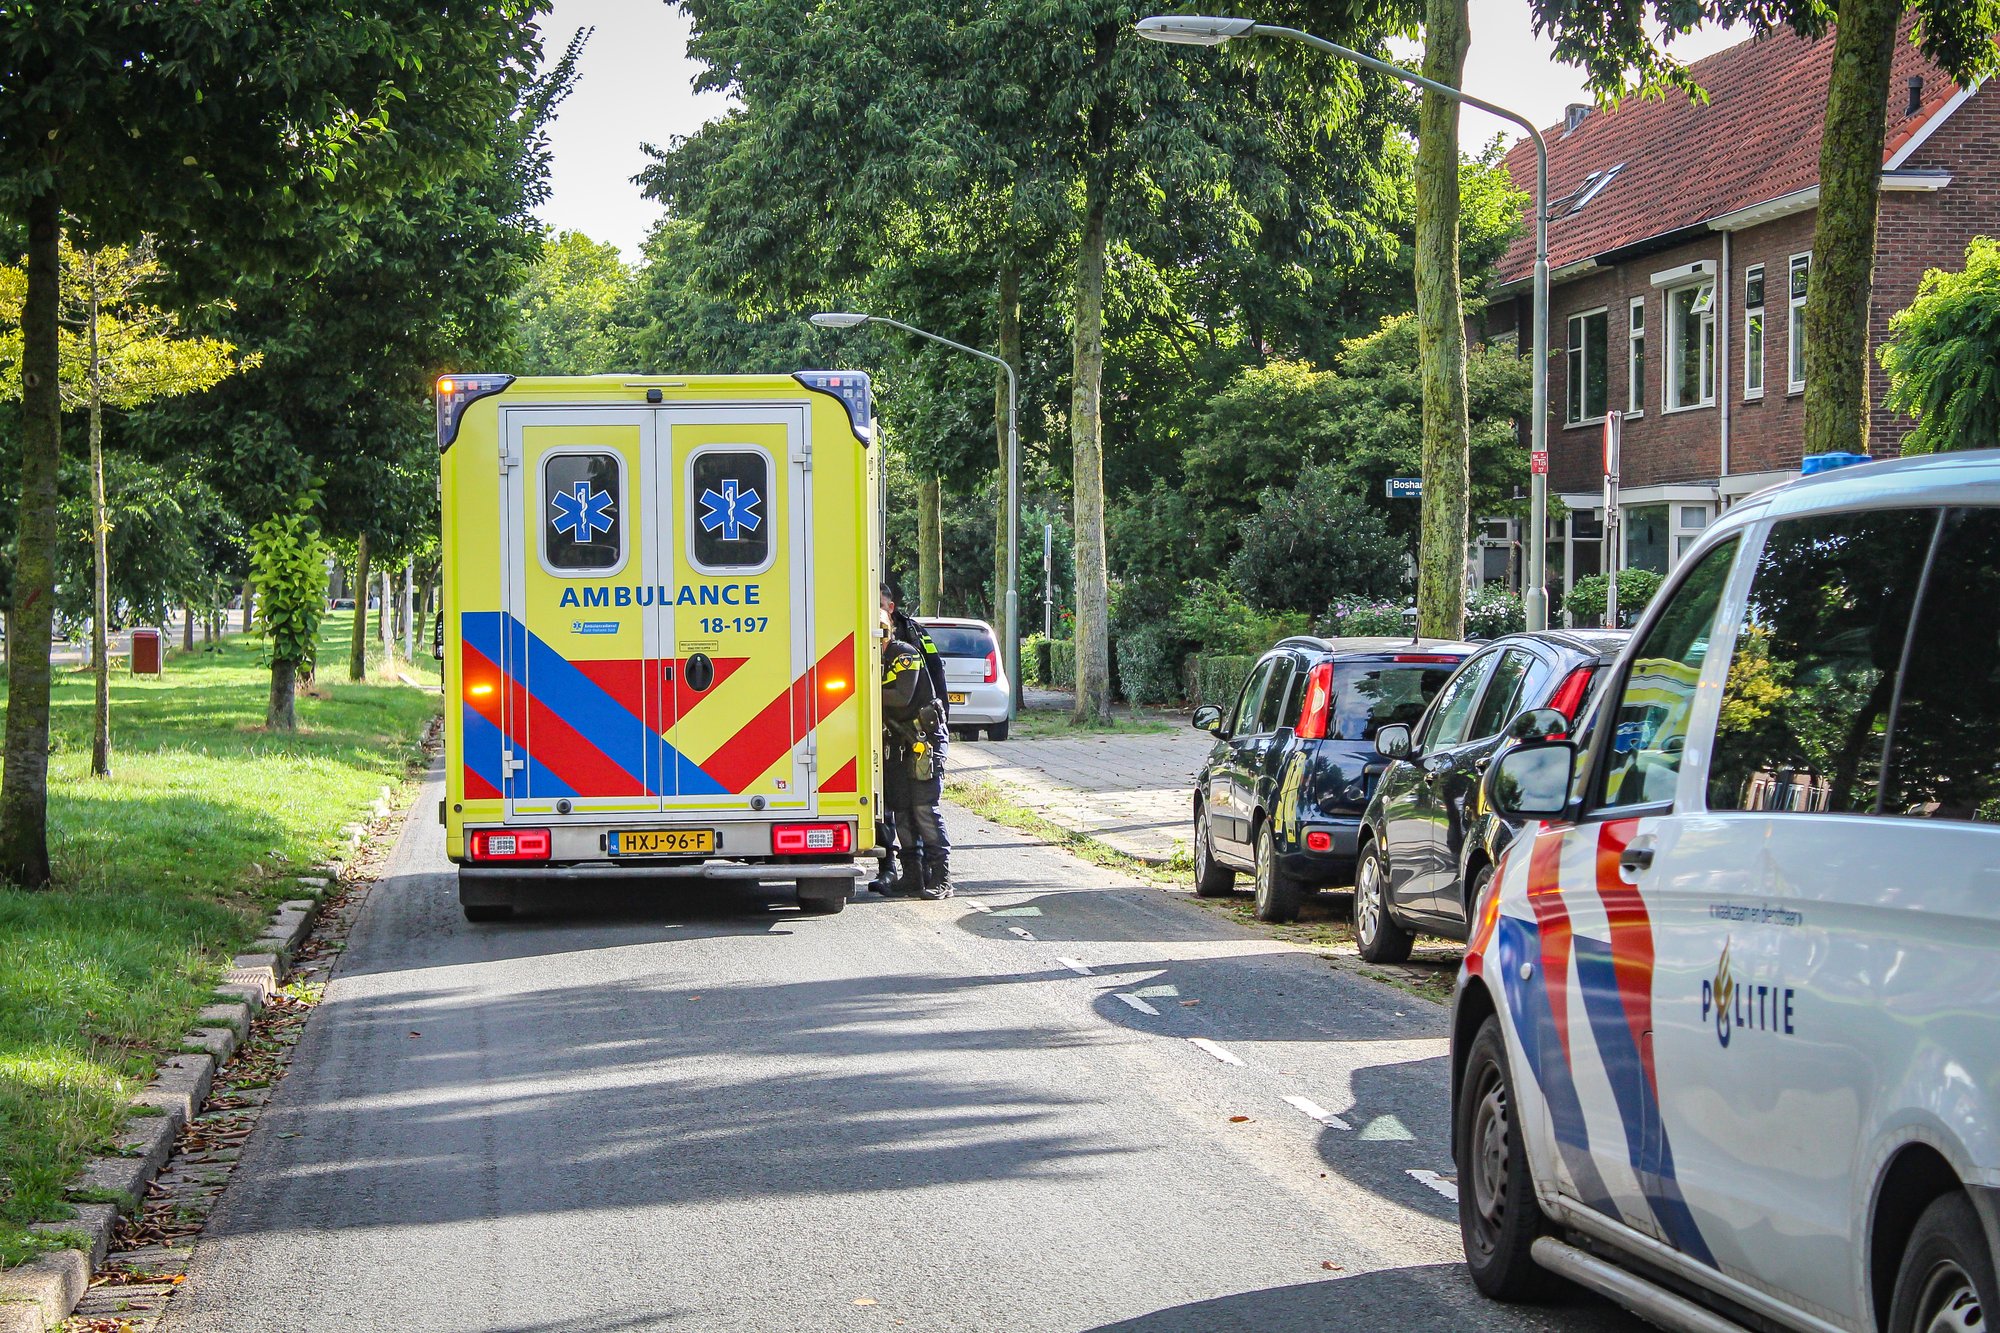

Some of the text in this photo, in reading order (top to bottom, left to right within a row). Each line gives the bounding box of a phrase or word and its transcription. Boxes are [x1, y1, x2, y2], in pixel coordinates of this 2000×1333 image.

[559, 584, 760, 608] AMBULANCE
[699, 617, 768, 634] 18-197
[626, 834, 706, 850] HXJ-96-F
[1702, 979, 1795, 1049] POLITIE
